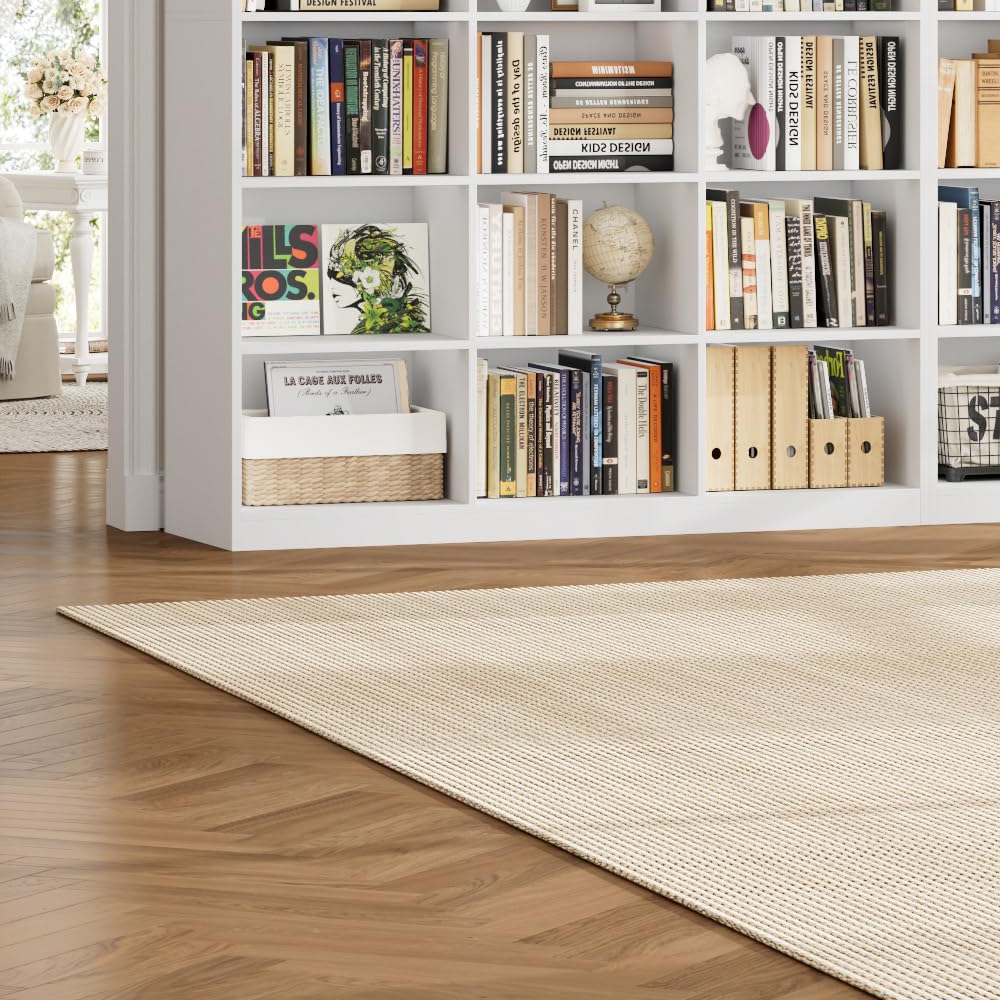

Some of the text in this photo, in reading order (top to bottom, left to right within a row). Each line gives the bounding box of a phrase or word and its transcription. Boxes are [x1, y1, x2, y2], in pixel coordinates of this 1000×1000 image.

[284, 374, 382, 385] LA CAGE AUX FOLLES
[528, 434, 535, 442] of
